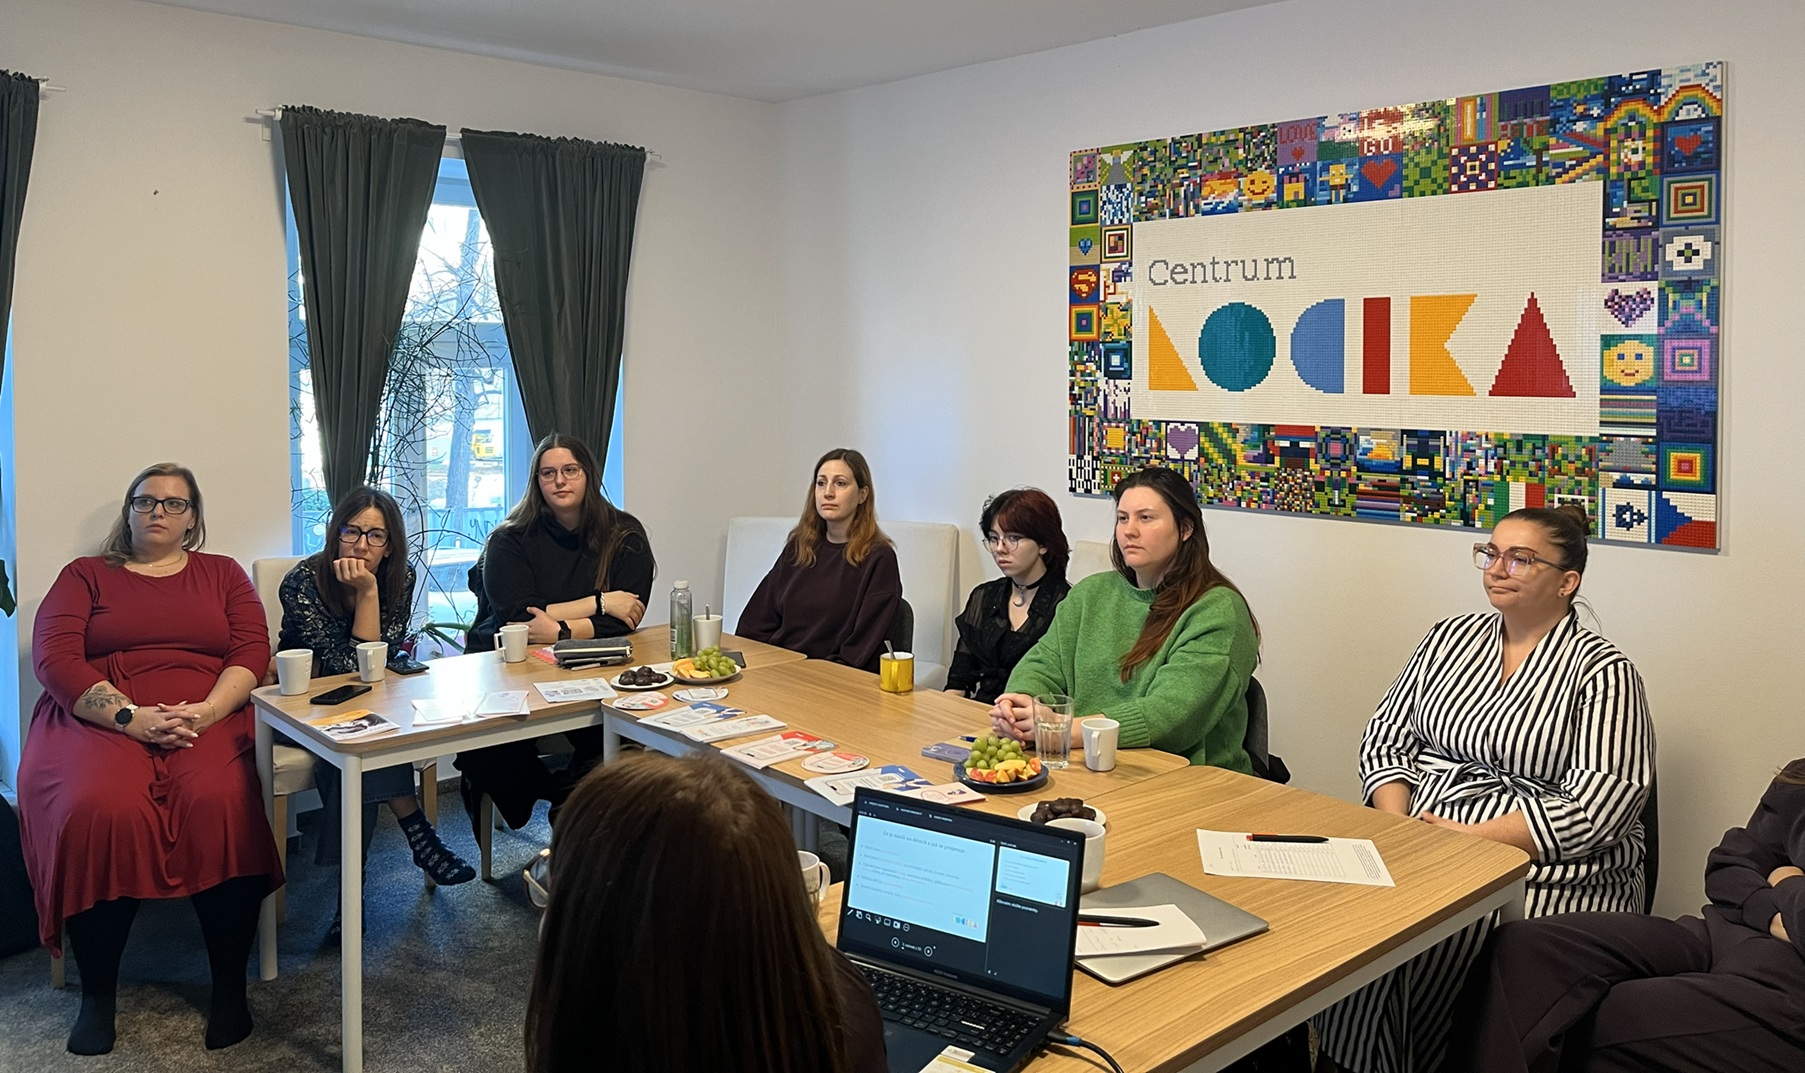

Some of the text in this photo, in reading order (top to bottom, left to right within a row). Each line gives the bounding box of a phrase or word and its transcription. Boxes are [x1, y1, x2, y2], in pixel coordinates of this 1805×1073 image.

[1279, 122, 1317, 144] LOVE
[1363, 137, 1392, 156] GO
[1149, 256, 1296, 285] Centrum
[1148, 291, 1576, 398] LOCIKA
